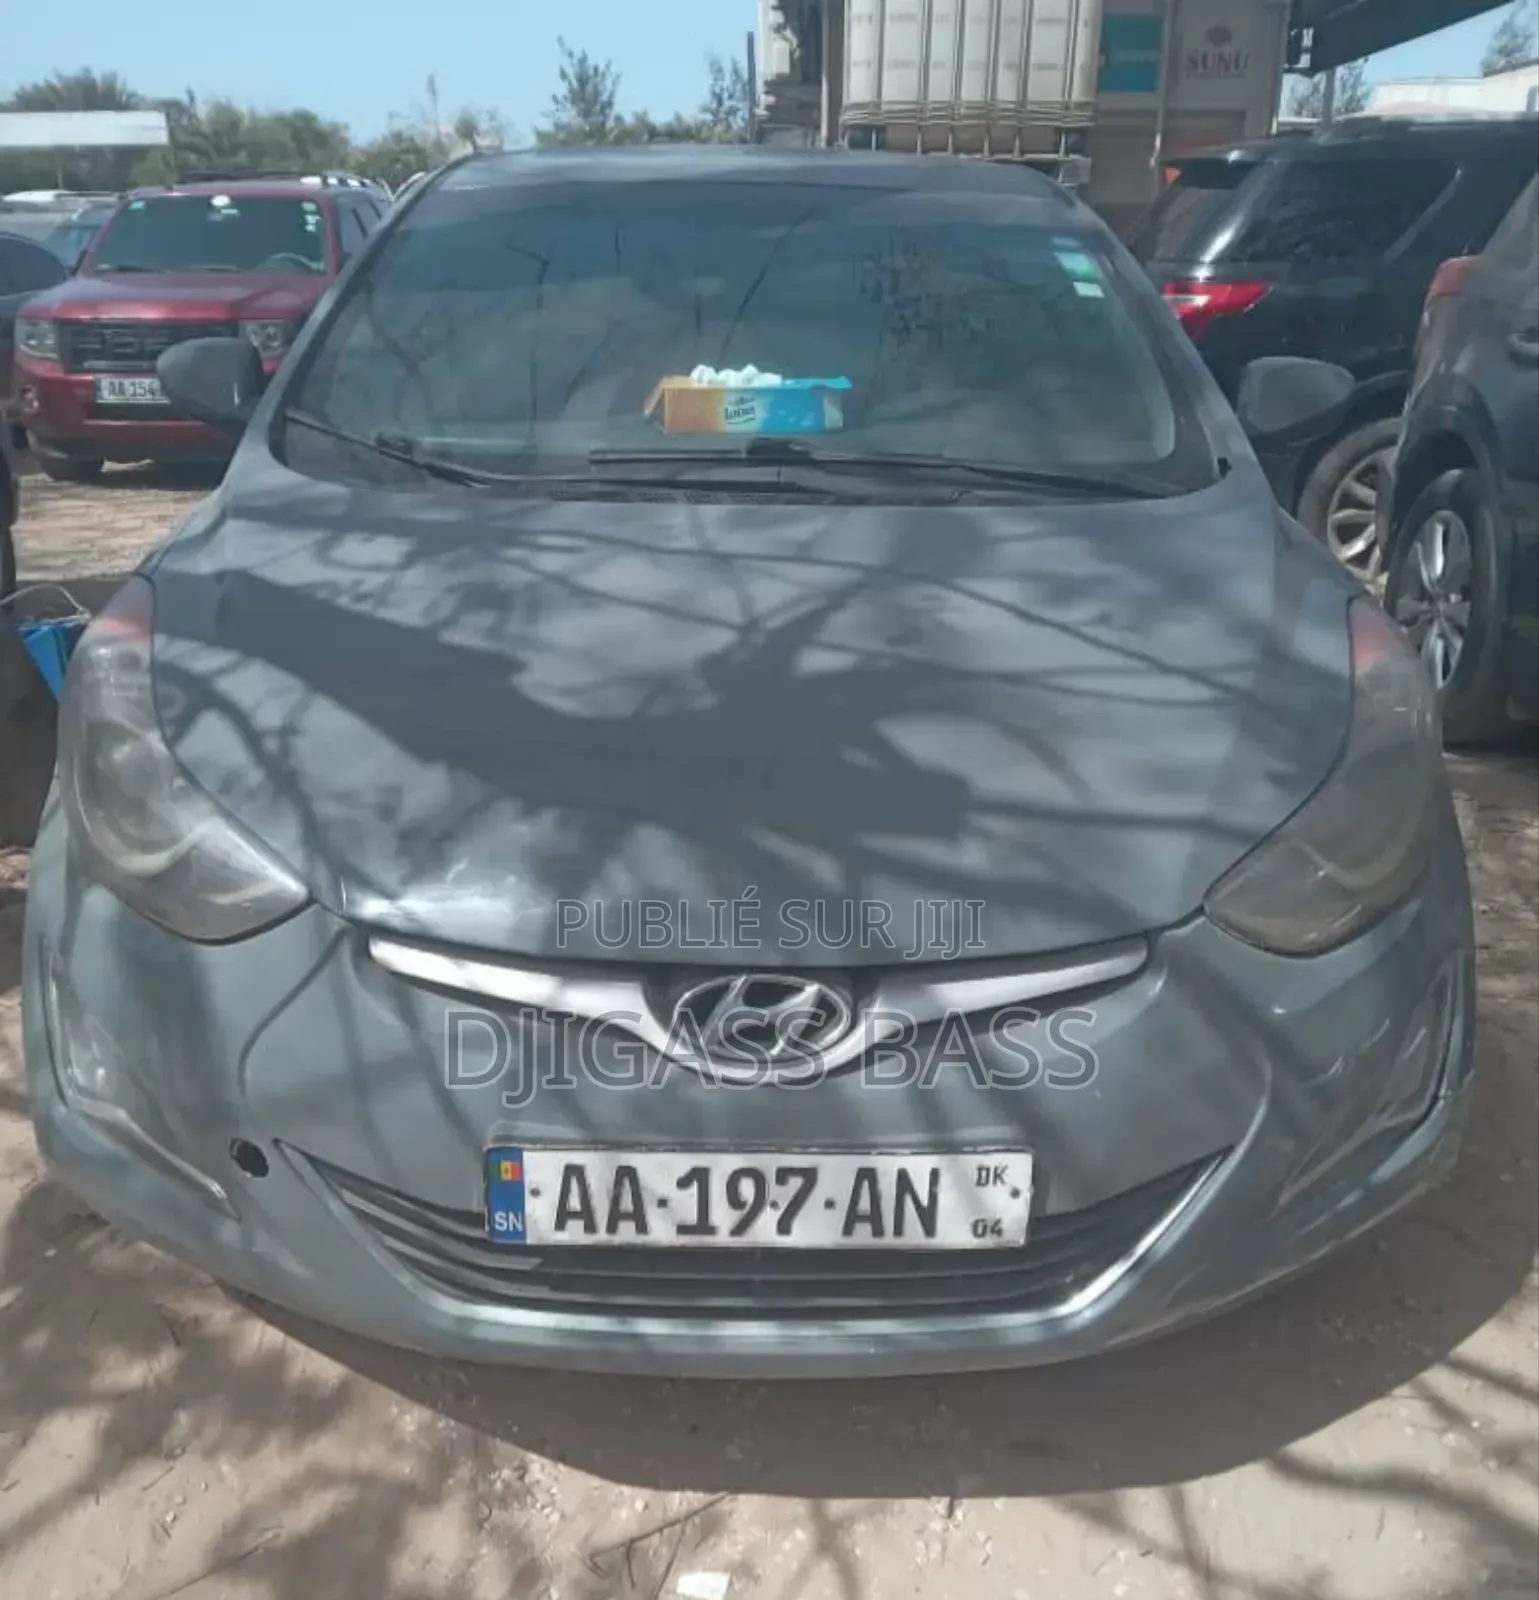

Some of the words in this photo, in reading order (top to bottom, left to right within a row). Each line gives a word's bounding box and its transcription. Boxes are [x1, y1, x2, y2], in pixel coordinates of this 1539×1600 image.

[975, 1165, 1008, 1187] DK
[494, 1211, 523, 1232] SN
[971, 1217, 1004, 1239] 04
